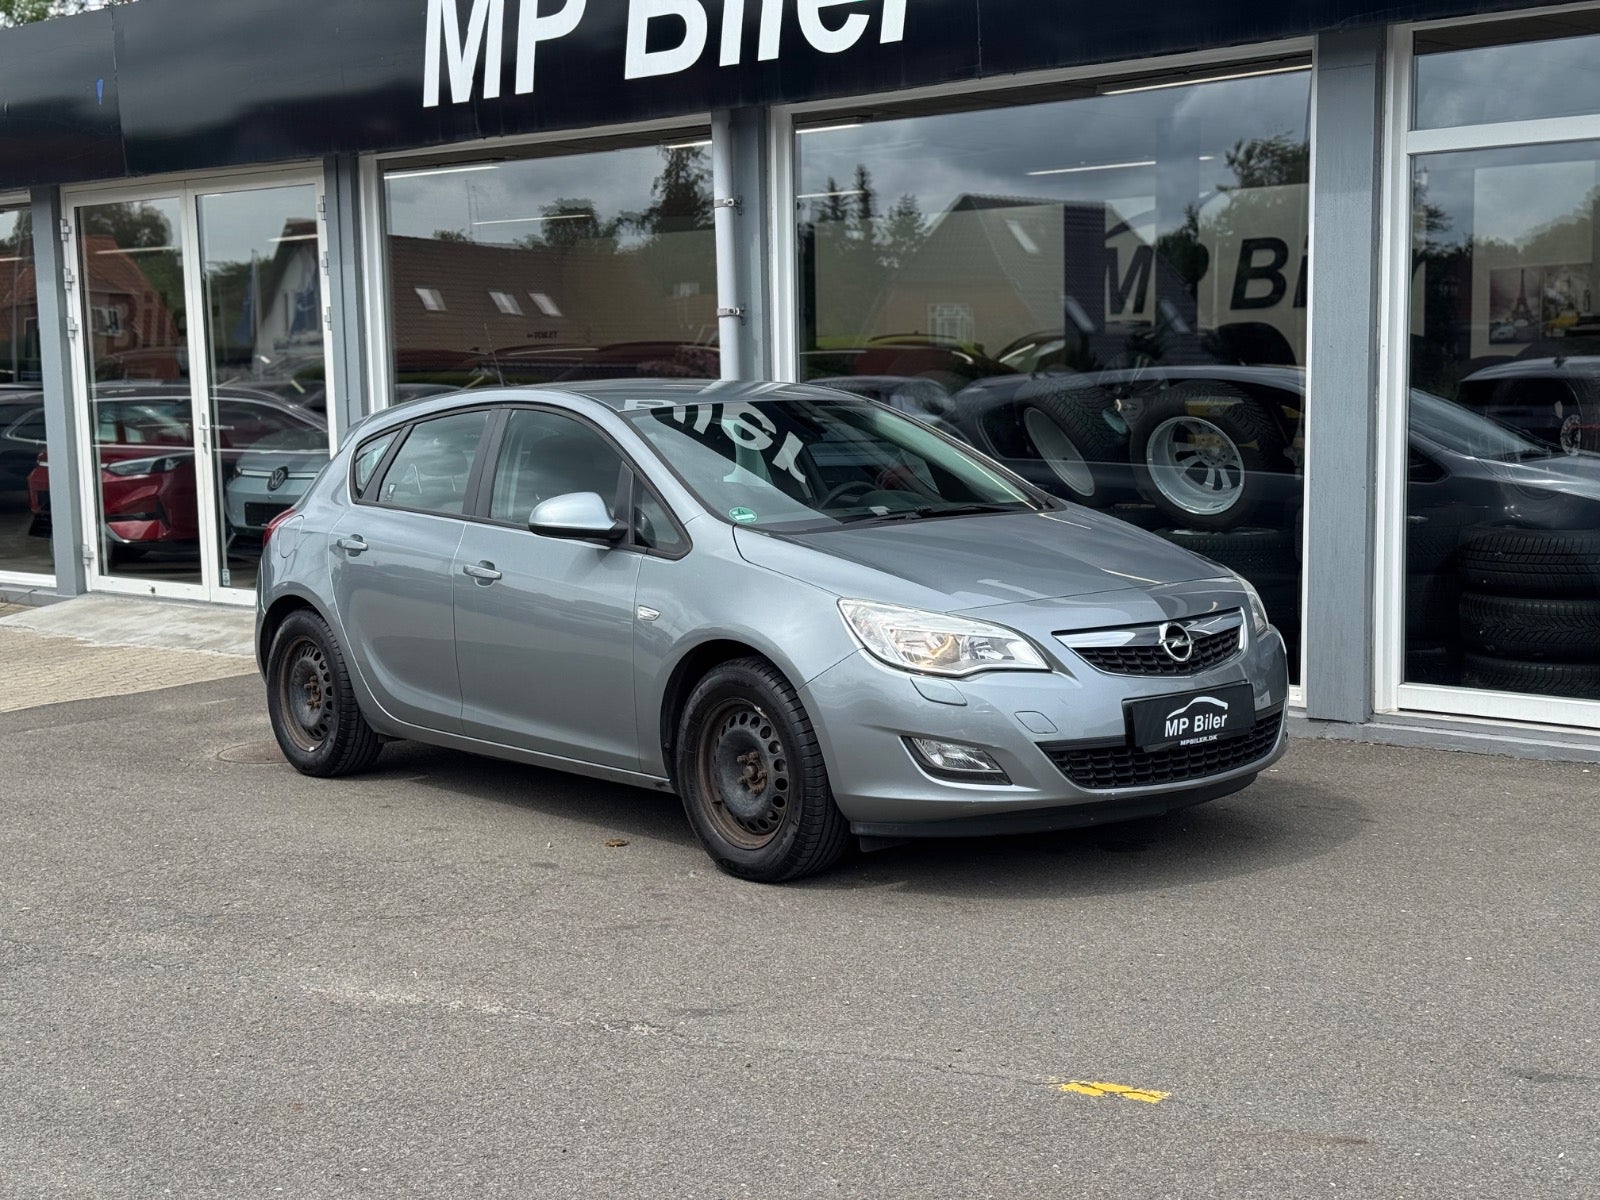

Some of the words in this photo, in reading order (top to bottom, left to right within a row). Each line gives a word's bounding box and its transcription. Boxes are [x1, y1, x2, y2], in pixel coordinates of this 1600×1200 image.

[423, 0, 586, 107] MP
[1165, 718, 1189, 737] MP
[1194, 713, 1227, 732] Biler
[1180, 735, 1217, 746] MPBILER.DK
